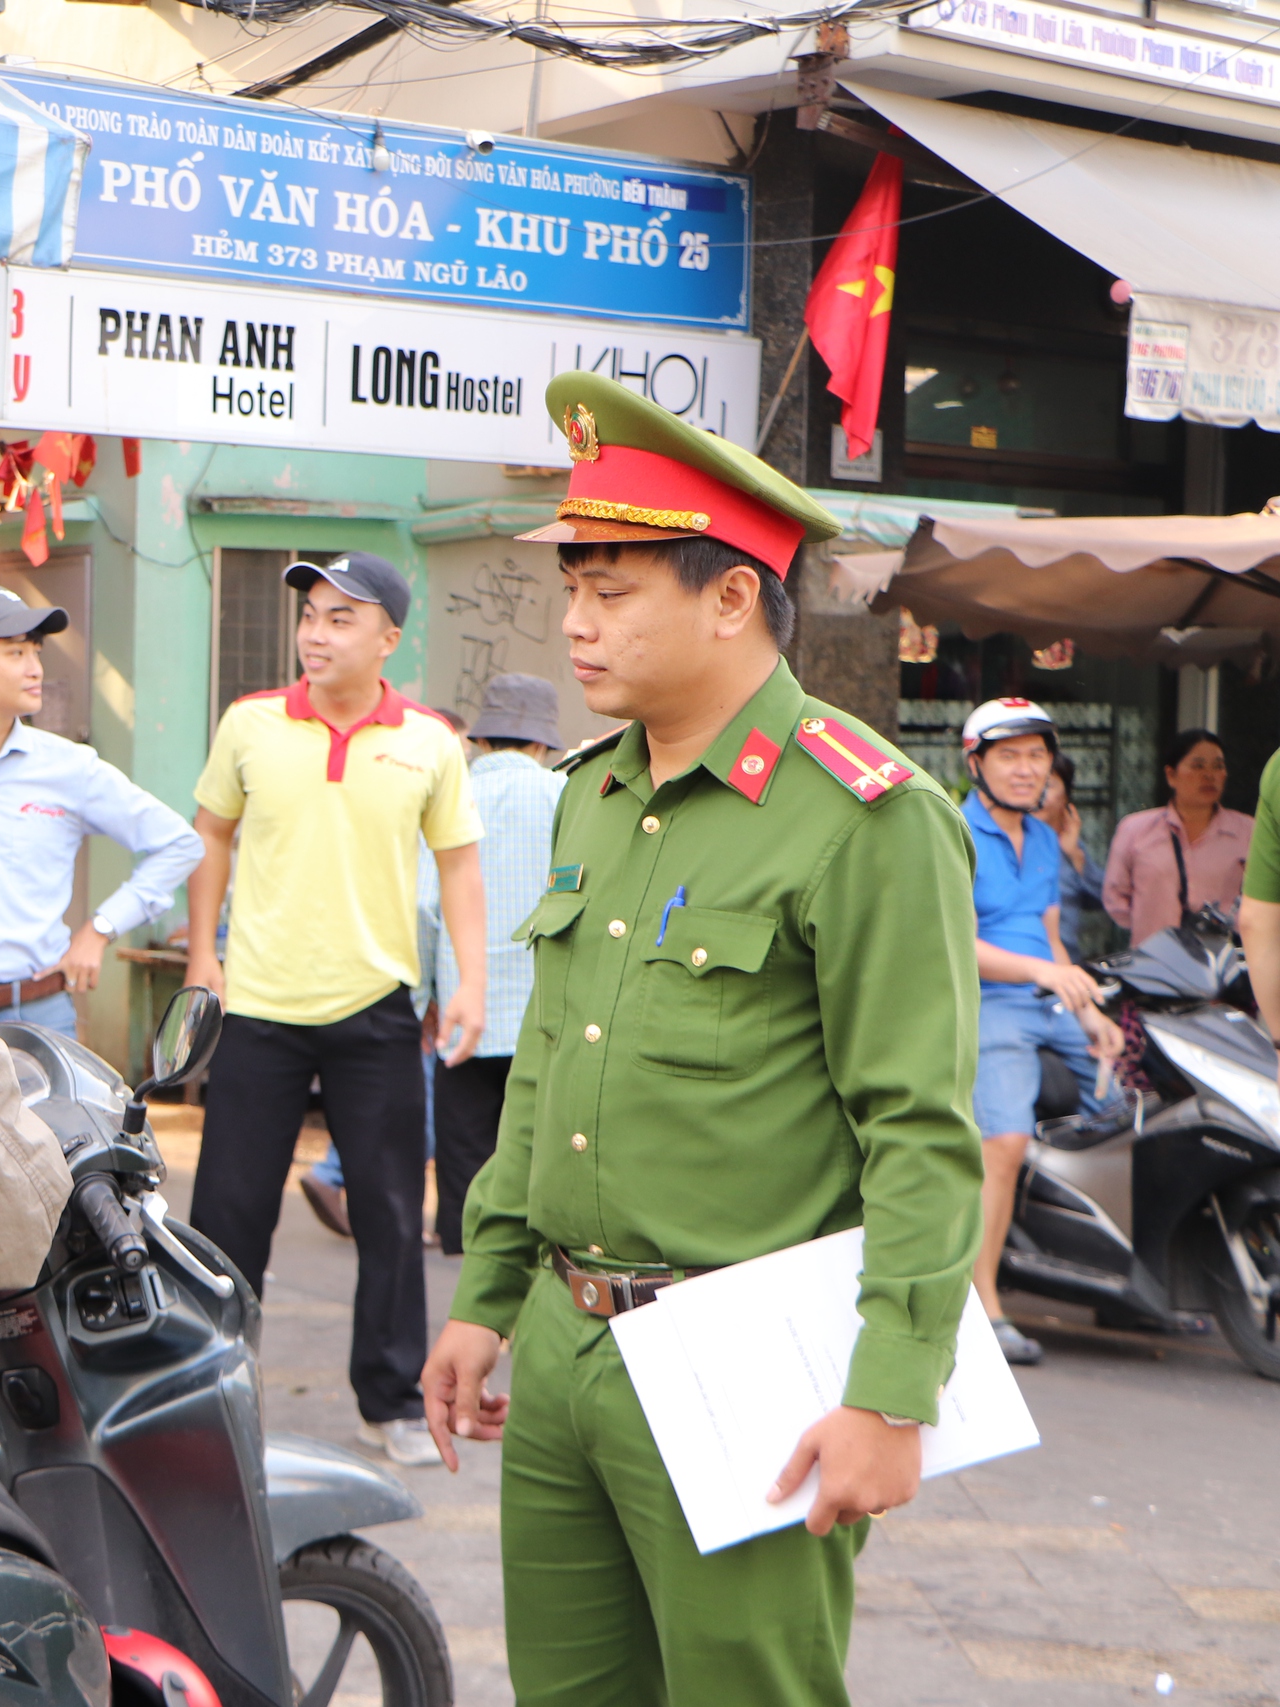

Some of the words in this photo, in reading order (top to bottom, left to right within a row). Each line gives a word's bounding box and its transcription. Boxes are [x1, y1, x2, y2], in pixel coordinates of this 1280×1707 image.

[64, 105, 122, 134] PHONG
[127, 111, 172, 141] TRÀO
[176, 117, 219, 147] TOÀN
[222, 124, 258, 152] DÂN
[260, 128, 304, 160] ĐOÀN
[307, 132, 341, 164] KẾT
[390, 149, 422, 178] ỰNG
[424, 151, 453, 179] ĐỜI
[455, 152, 496, 184] SỐNG
[498, 160, 529, 189] VĂN
[530, 165, 562, 193] HÓA
[564, 164, 621, 201] PHƯỜNG
[622, 176, 646, 205] BẾN
[648, 181, 688, 212] THÀNH
[99, 151, 205, 212] PHỐ
[219, 169, 319, 228] VĂN
[333, 185, 434, 242] HÓA
[475, 207, 571, 257] KHU
[583, 211, 672, 268] PHỐ
[678, 230, 710, 272] 25
[192, 230, 258, 263] HẺM
[267, 244, 319, 271] 373
[326, 250, 406, 283] PHẠM
[414, 259, 469, 287] NGŨ
[477, 264, 528, 292] LÃO
[98, 307, 204, 363] PHAN
[219, 320, 296, 371] ANH
[212, 375, 294, 420] Hotel
[351, 344, 440, 410] LONG
[446, 371, 522, 417] Hostel
